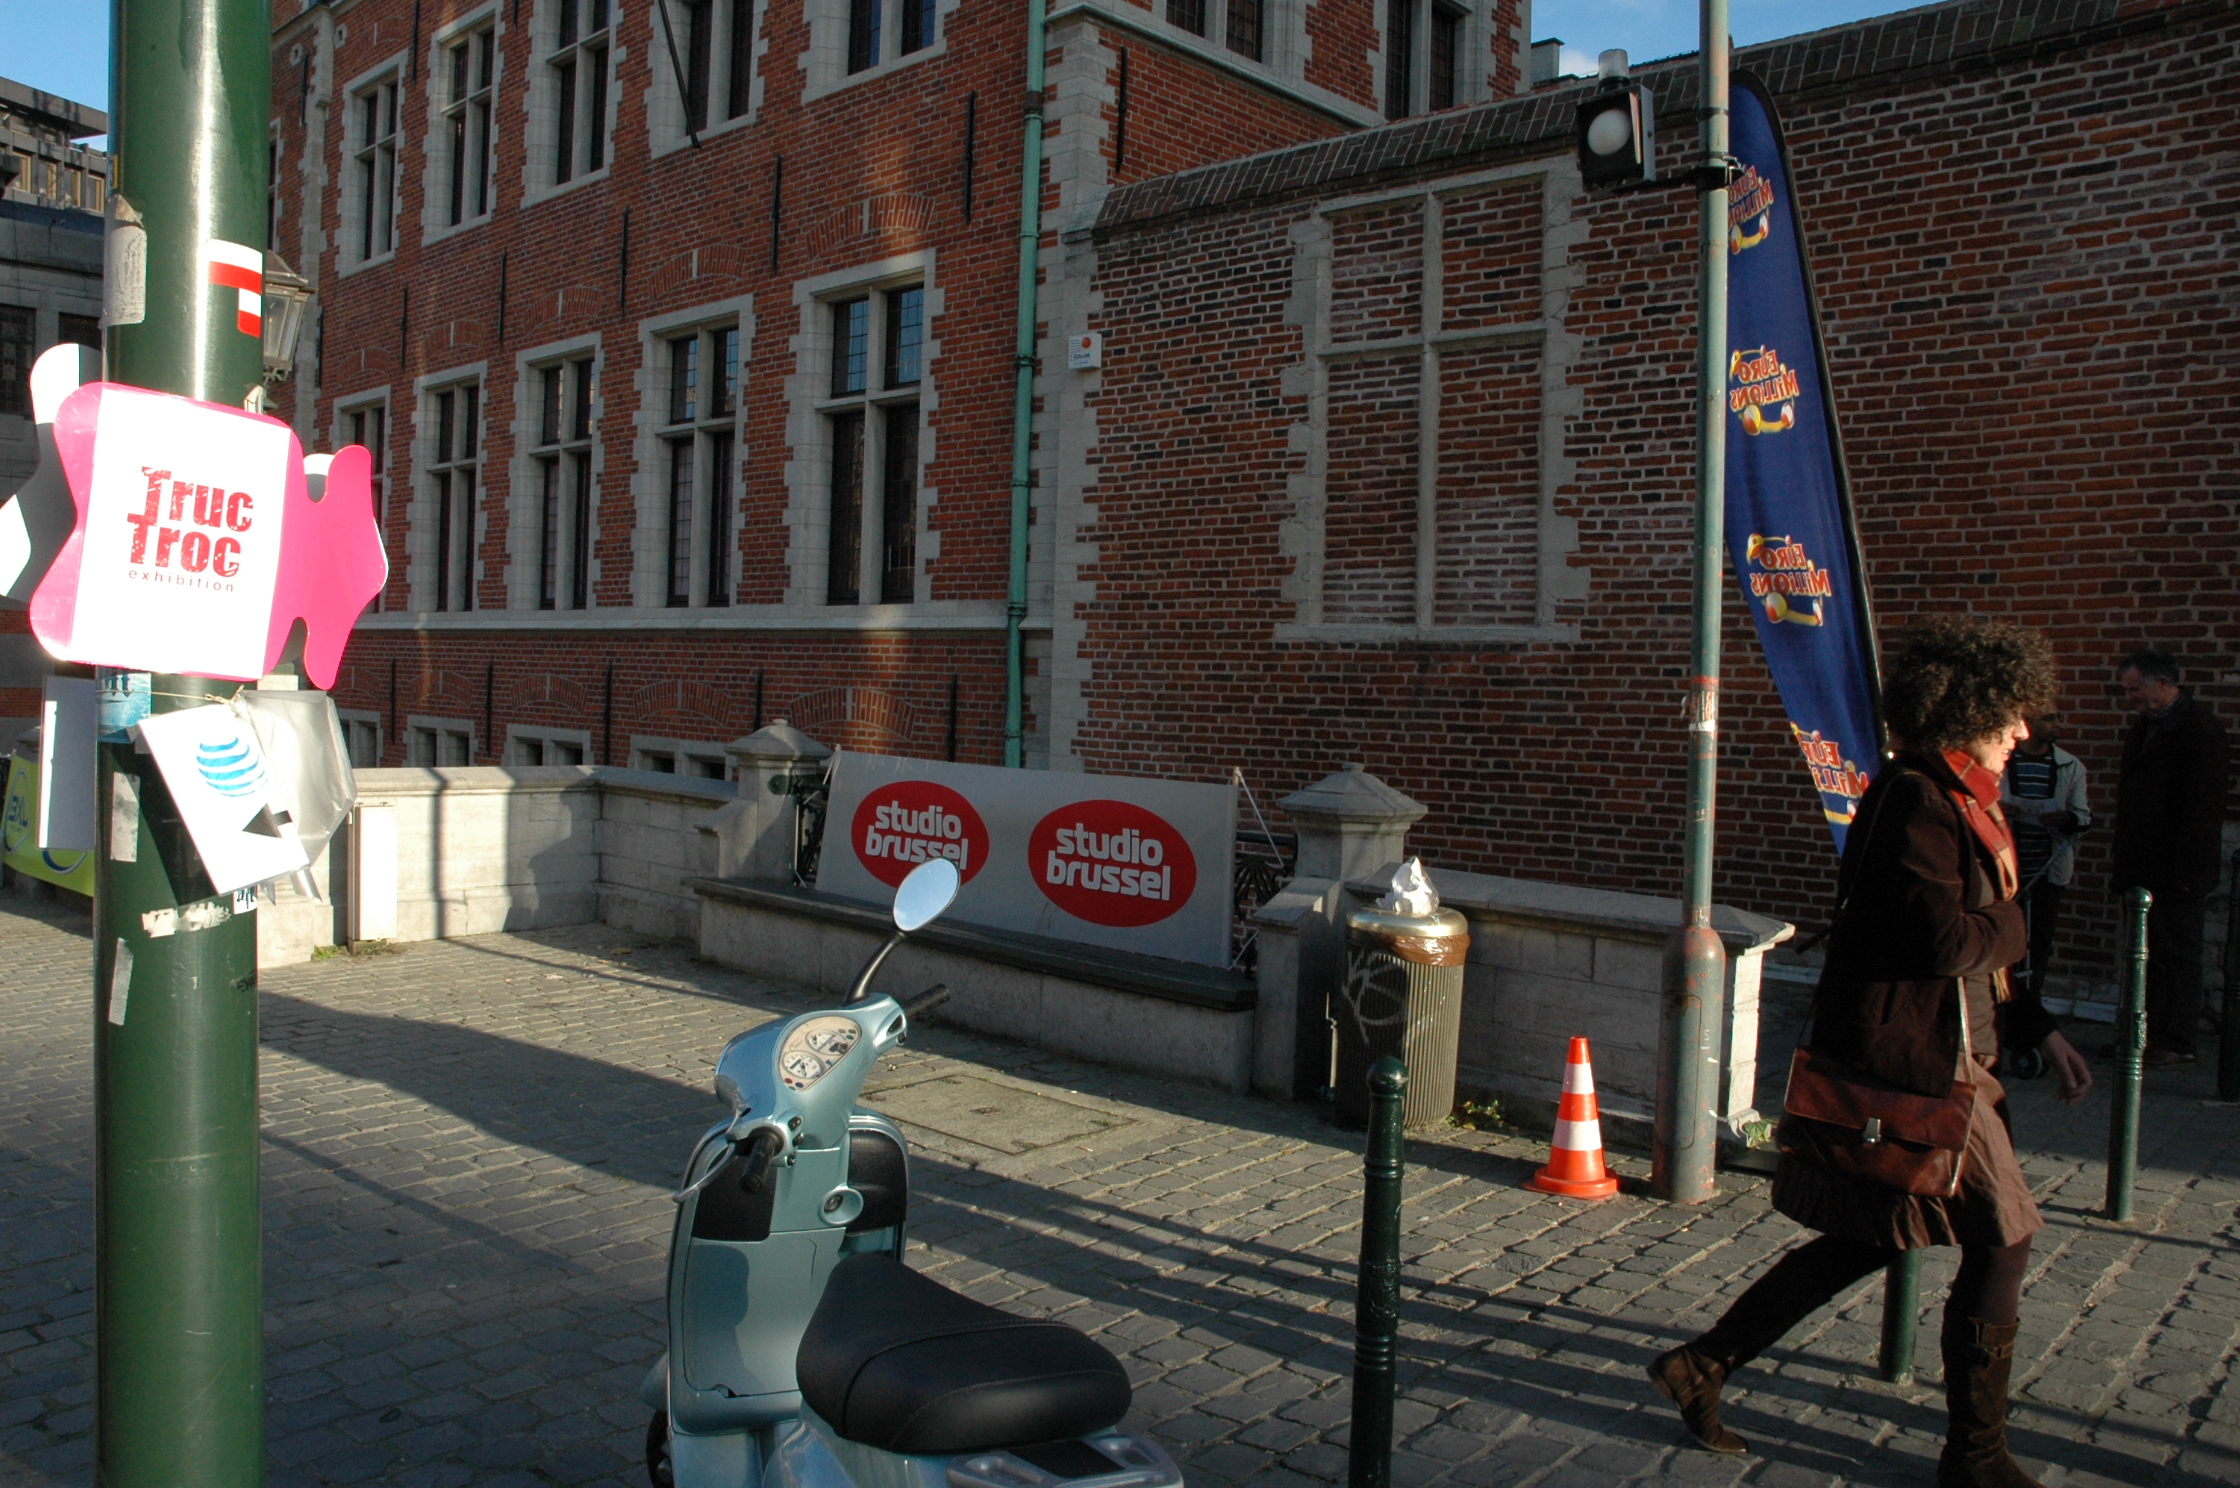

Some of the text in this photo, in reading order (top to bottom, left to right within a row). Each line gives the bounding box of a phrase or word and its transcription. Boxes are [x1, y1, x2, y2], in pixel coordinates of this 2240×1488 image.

[141, 466, 253, 532] Truc
[127, 513, 241, 577] Troc
[128, 569, 234, 592] exhibition
[875, 800, 962, 840] studio
[865, 825, 969, 871] brussel
[1056, 822, 1163, 867] studio
[1046, 849, 1171, 901] brussel
